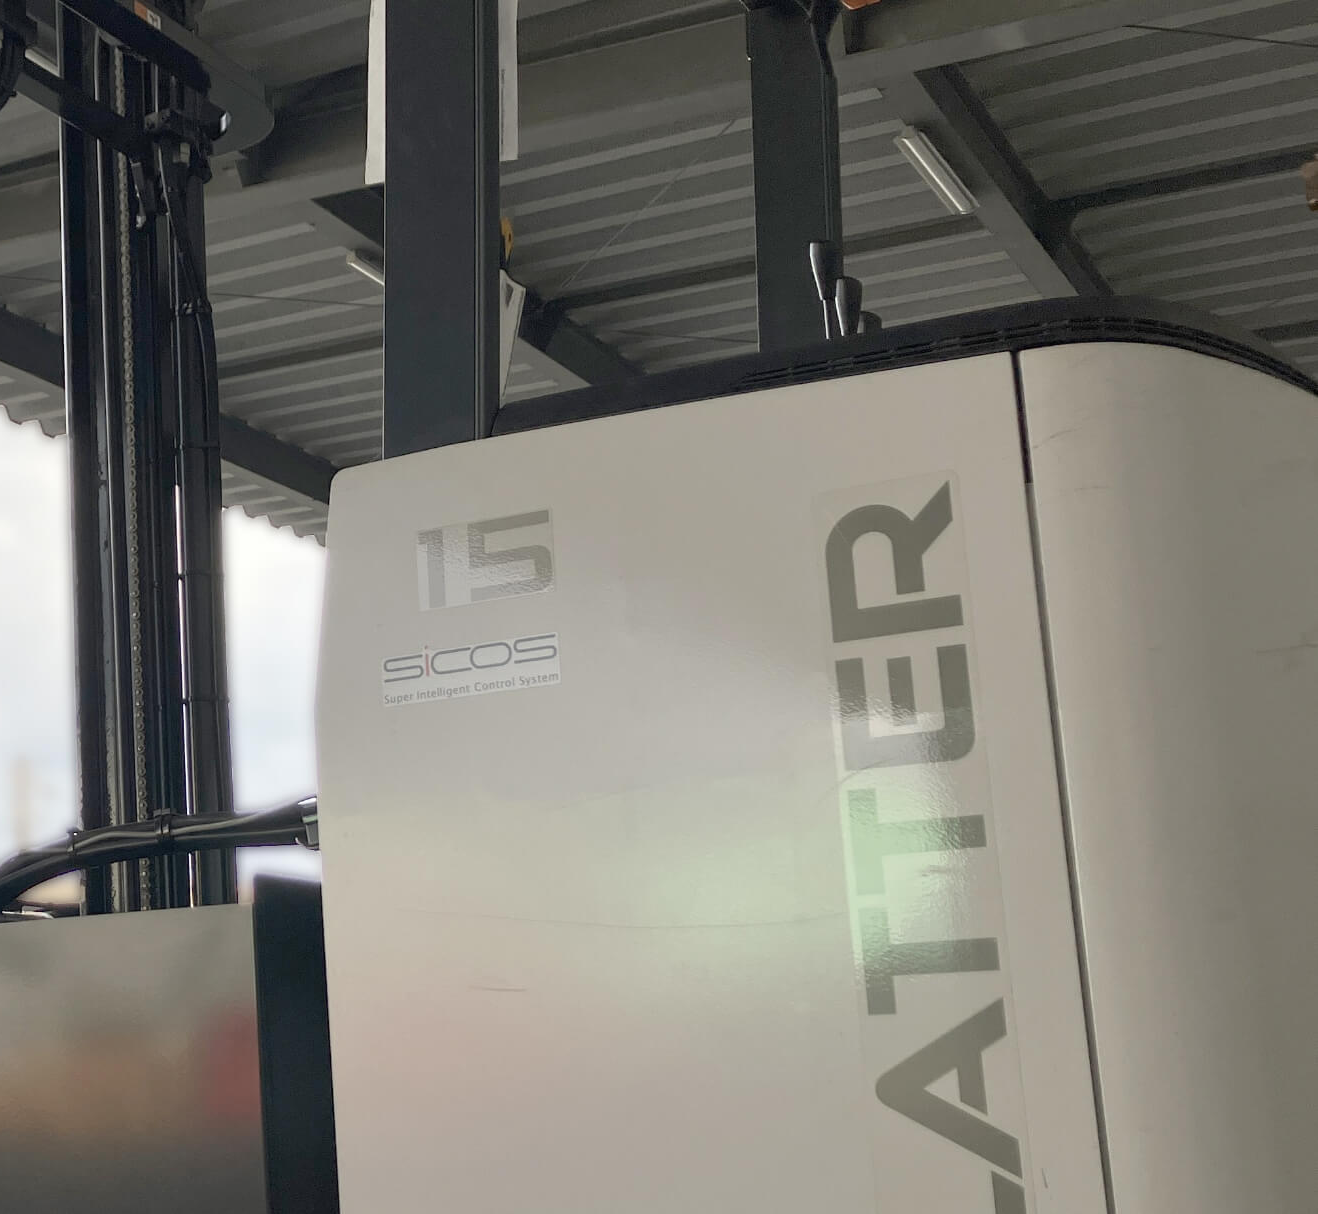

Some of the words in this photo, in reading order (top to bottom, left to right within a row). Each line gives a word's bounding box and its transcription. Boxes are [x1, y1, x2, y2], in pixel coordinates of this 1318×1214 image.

[417, 509, 554, 609] 15
[384, 692, 414, 705] Super
[416, 684, 471, 702] Intelligent
[474, 677, 516, 692] Control
[518, 671, 560, 688] System
[824, 479, 1027, 1214] ATTER
